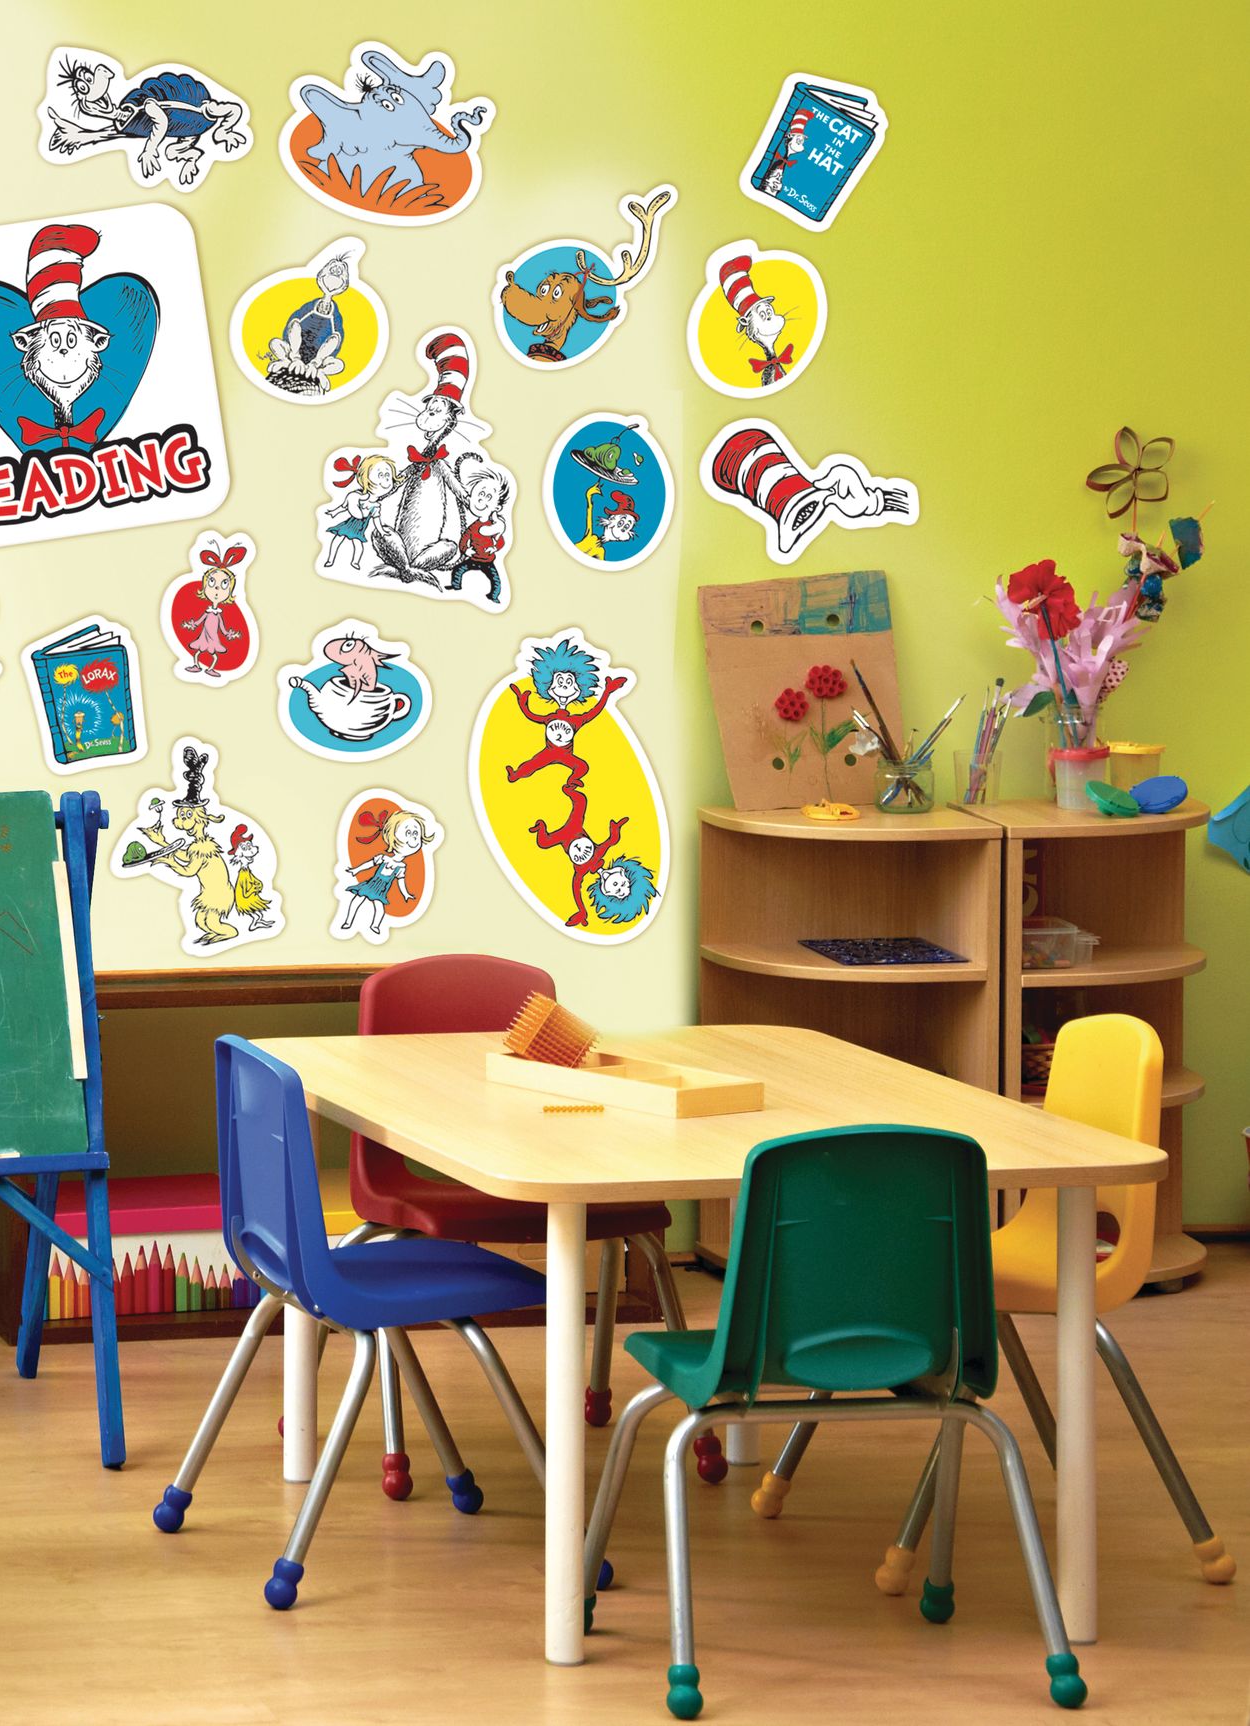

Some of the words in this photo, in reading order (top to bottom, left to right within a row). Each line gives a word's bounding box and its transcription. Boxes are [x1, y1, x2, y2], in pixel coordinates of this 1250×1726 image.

[811, 106, 830, 123] THE
[828, 118, 863, 144] CAT
[824, 144, 842, 159] THE
[832, 137, 845, 148] IN
[807, 147, 844, 176] HAT
[787, 187, 799, 200] Dr.
[798, 194, 817, 213] Seuss
[58, 670, 73, 679] The
[81, 667, 117, 685] LORAX
[549, 722, 571, 735] THING
[556, 733, 563, 742] 2
[573, 845, 593, 863] THING
